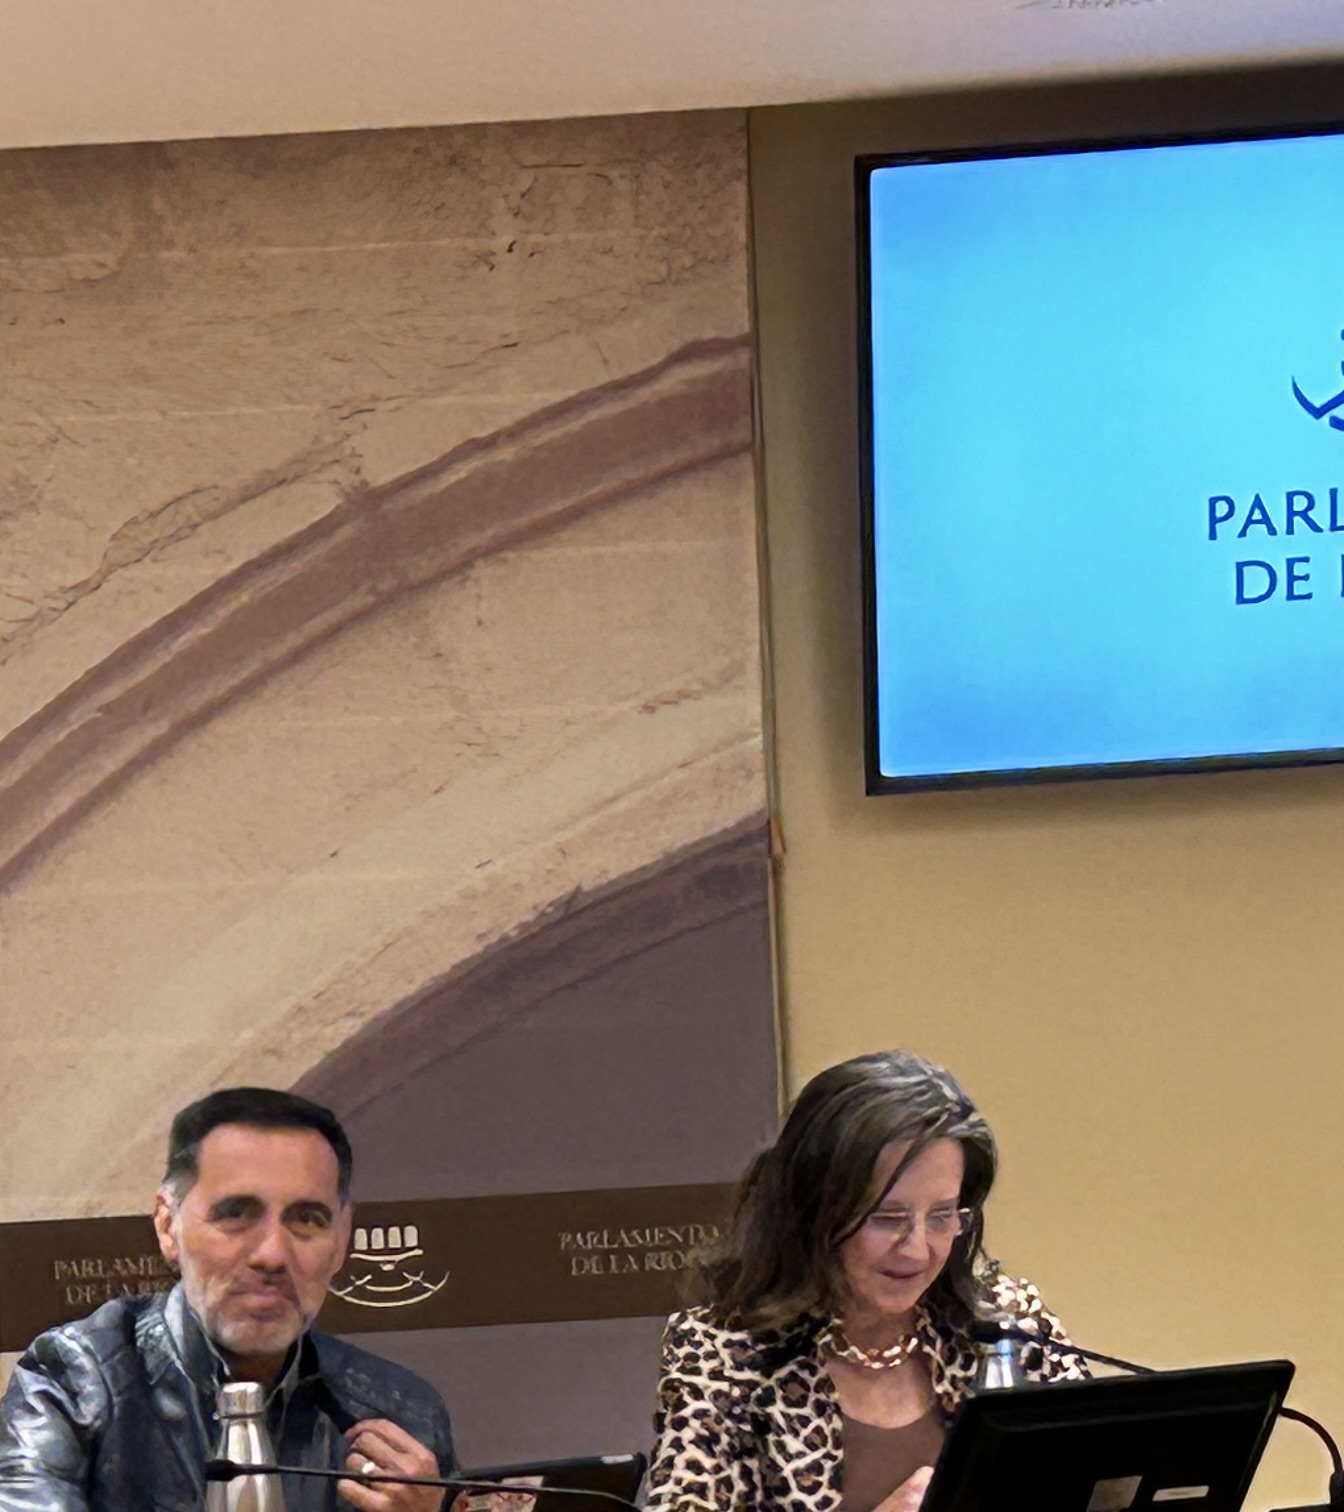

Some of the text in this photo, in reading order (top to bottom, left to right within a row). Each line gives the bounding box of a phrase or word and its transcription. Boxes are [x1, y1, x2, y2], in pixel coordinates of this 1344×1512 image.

[1235, 556, 1313, 605] DE
[558, 1223, 721, 1251] PARLAMENTO
[571, 1255, 603, 1276] DE
[609, 1253, 639, 1274] LA
